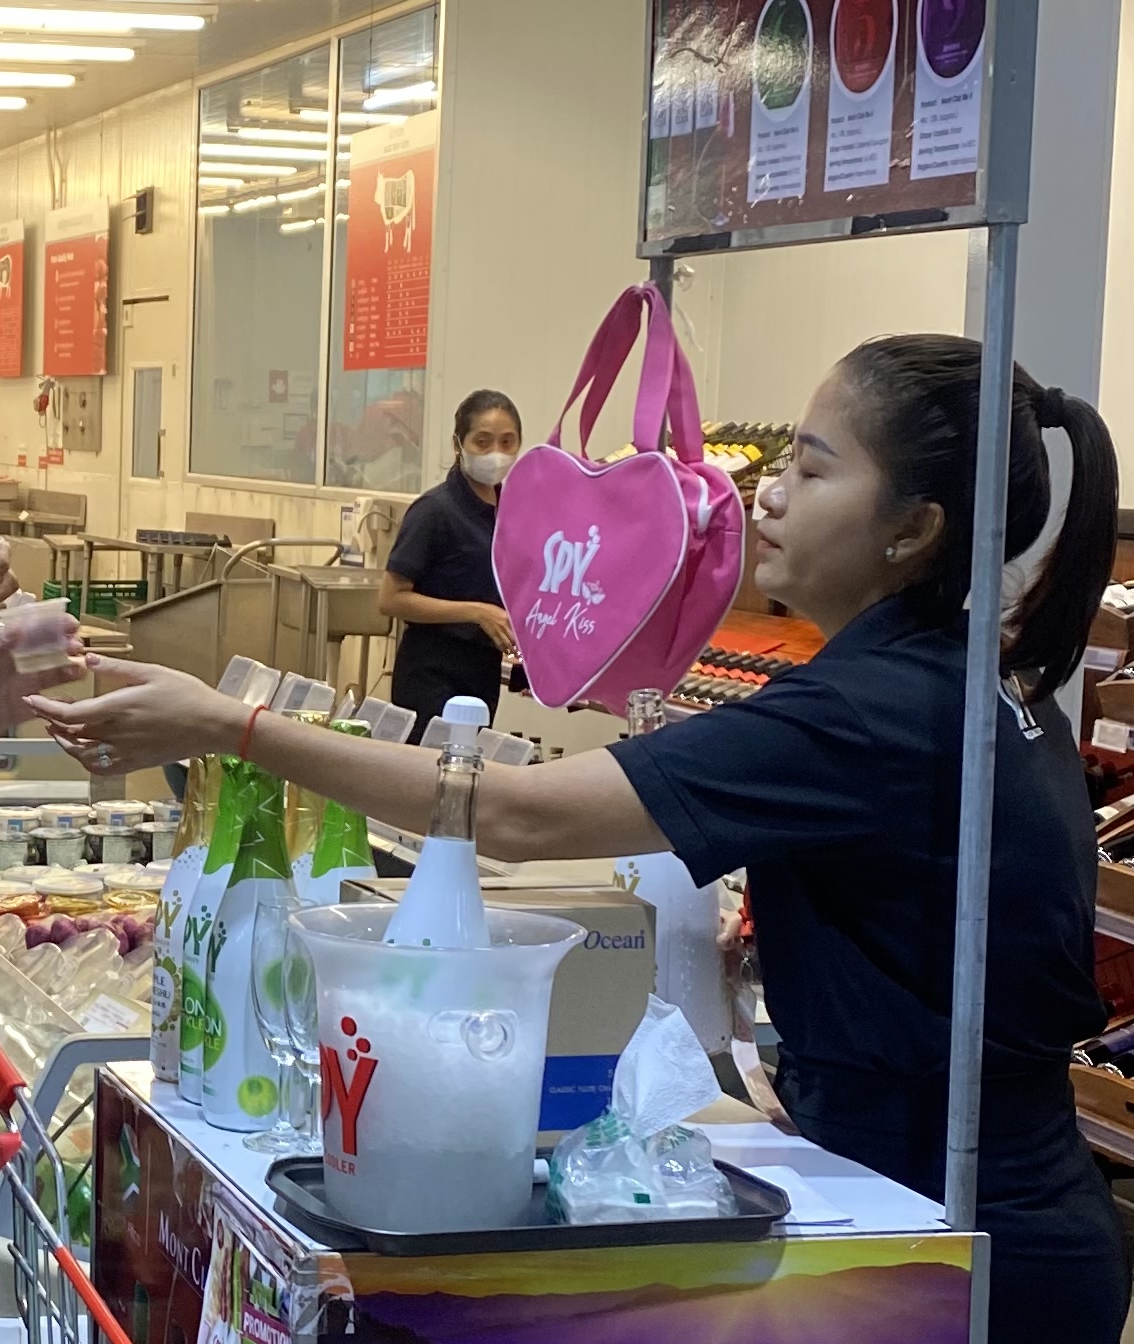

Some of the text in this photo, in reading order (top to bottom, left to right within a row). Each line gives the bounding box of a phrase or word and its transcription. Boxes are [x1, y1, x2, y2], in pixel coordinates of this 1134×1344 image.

[538, 528, 601, 597] SPY
[525, 598, 596, 641] Angel Kiss
[584, 929, 646, 950] Ocean
[158, 1209, 190, 1273] MONT
